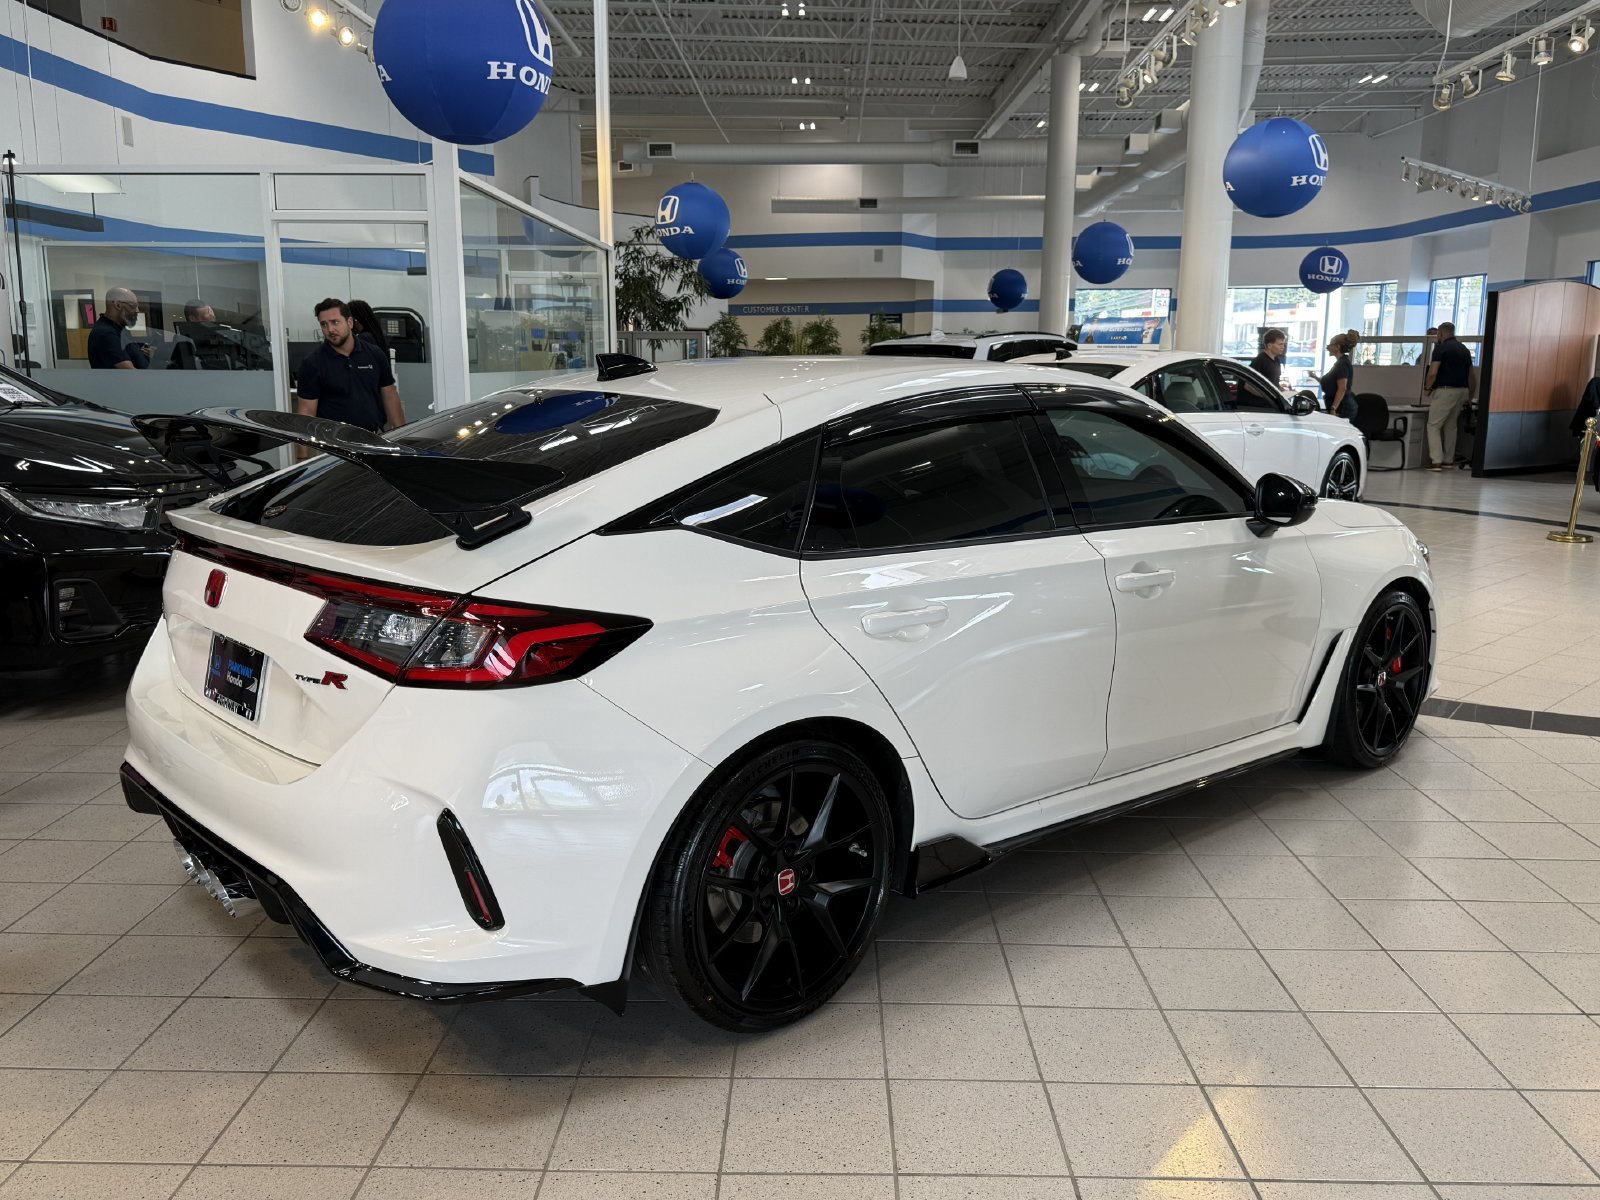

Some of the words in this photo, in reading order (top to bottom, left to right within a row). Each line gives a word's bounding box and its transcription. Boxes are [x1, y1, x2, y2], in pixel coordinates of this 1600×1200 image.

[742, 306, 780, 314] CUSTOMER
[781, 305, 810, 314] CENTER
[227, 659, 255, 679] PARKWAY
[226, 670, 243, 688] Honda
